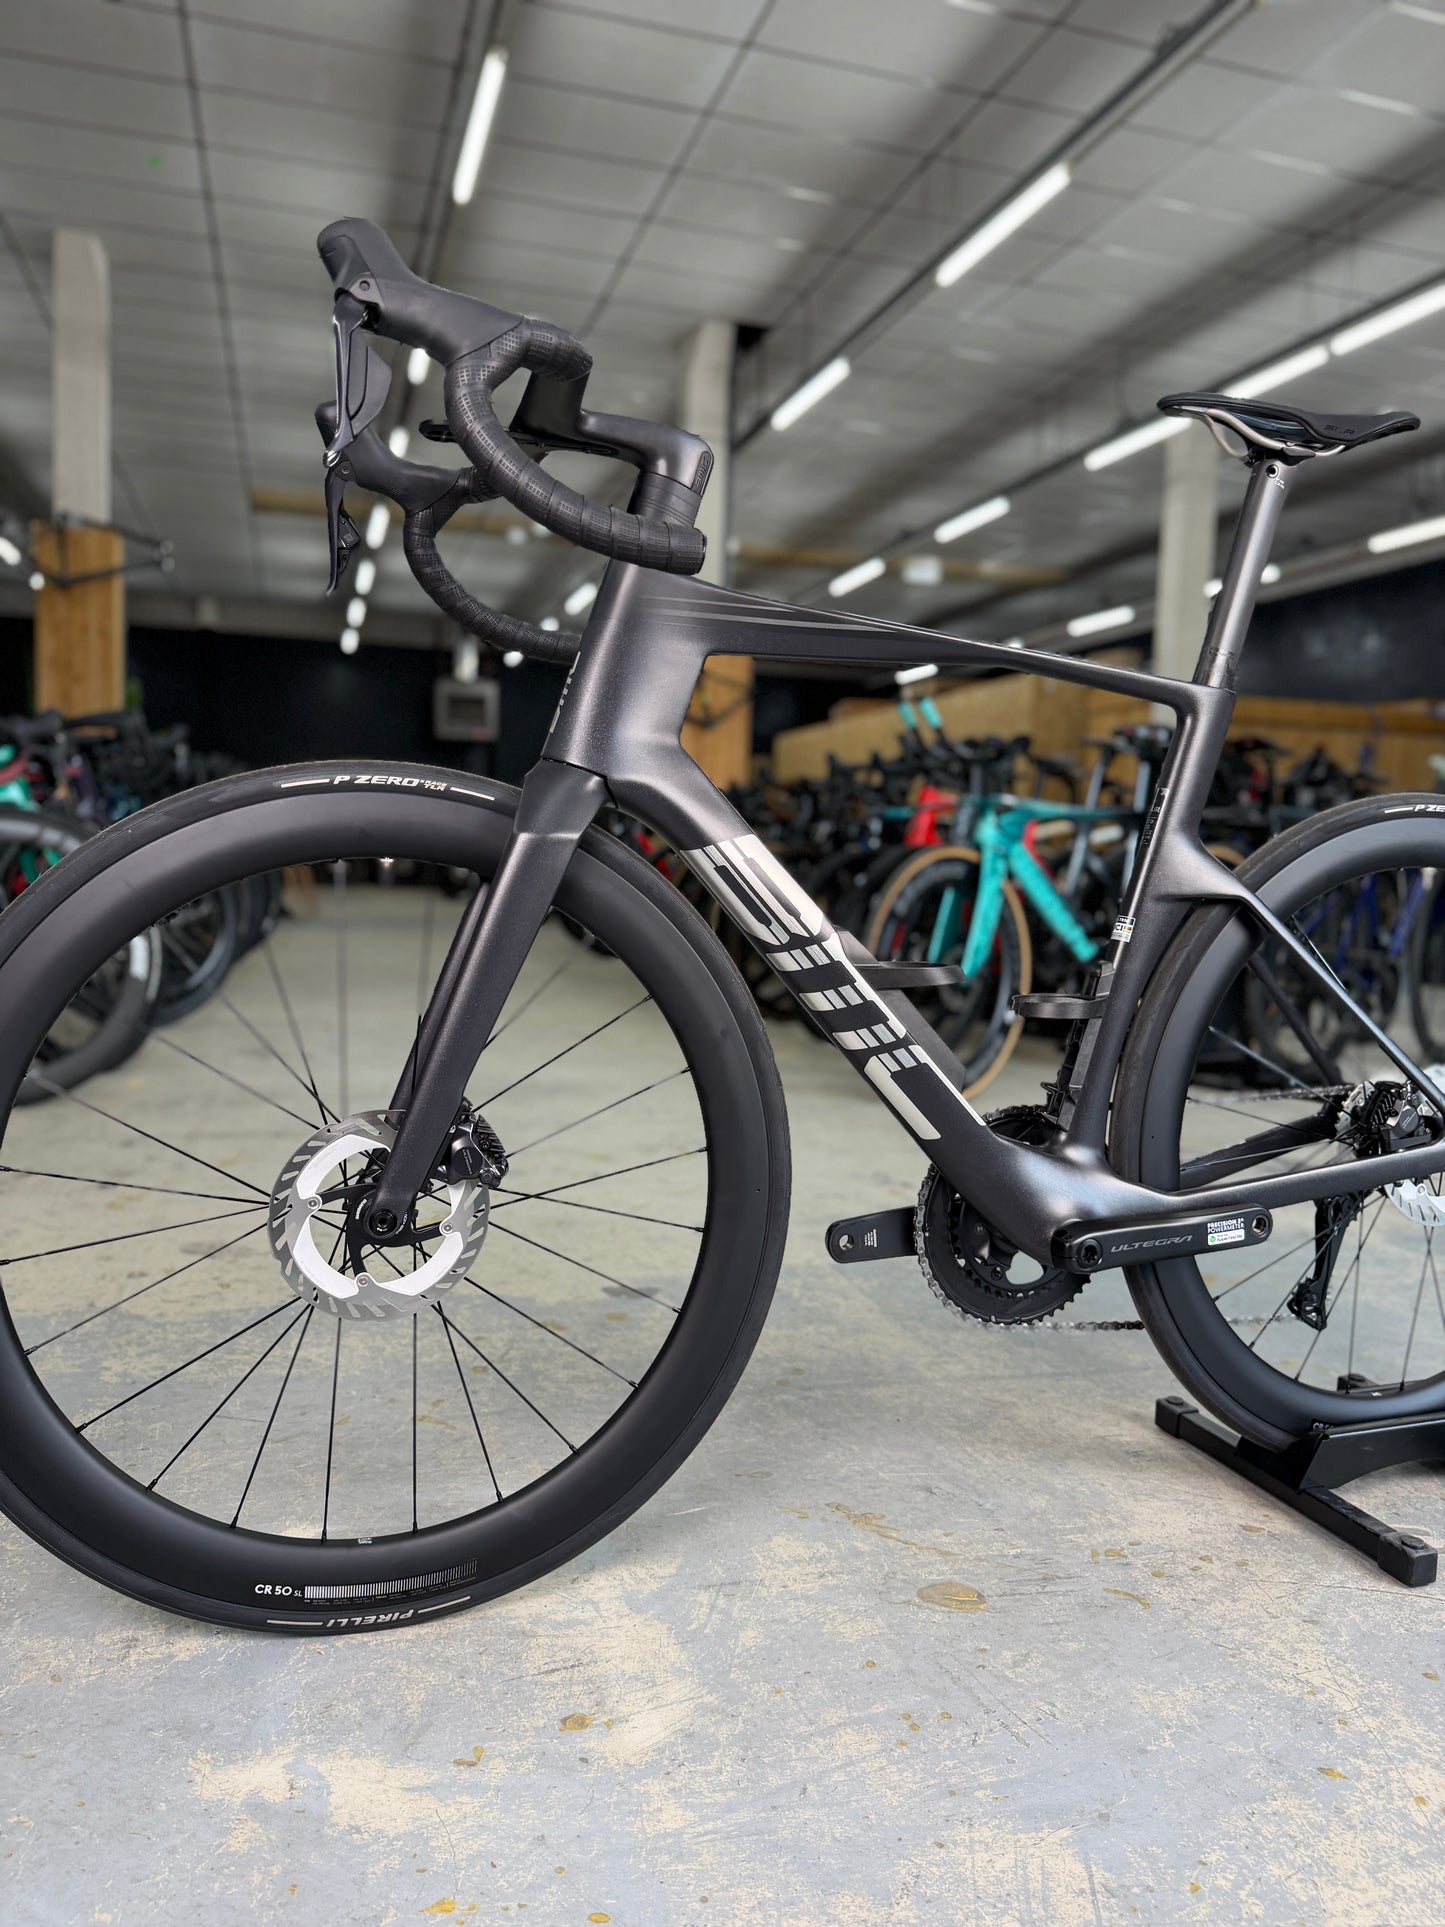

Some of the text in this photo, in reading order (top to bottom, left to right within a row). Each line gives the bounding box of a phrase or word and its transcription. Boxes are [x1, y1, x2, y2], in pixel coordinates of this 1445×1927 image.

[333, 775, 418, 787] P ZERO
[1207, 1219, 1237, 1228] PRECISION
[1207, 1223, 1245, 1234] POWERMETER
[1111, 1235, 1192, 1252] ULTEGRA
[254, 1584, 272, 1595] CR
[274, 1585, 292, 1596] 50
[327, 1609, 414, 1627] PIRELLI
